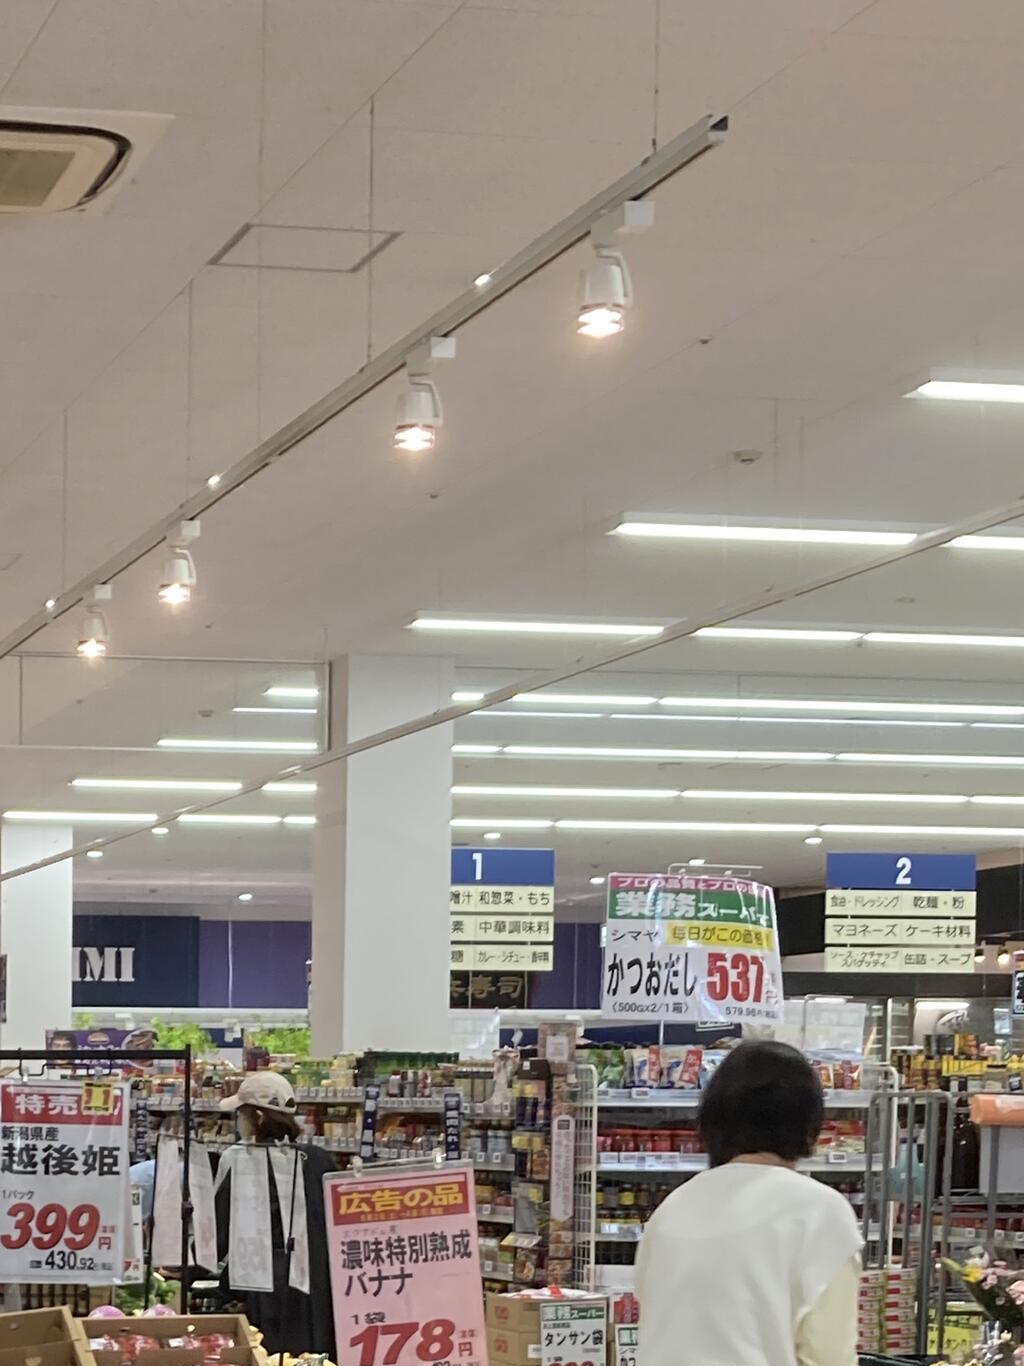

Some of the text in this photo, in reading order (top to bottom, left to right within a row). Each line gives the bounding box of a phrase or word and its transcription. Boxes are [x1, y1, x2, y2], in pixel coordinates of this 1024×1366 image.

[472, 852, 483, 880] 1
[895, 856, 912, 885] 2
[479, 920, 550, 935] 中華調味料
[611, 928, 658, 942] シマヤ
[832, 923, 971, 938] マヨネーズ ケーキ材料
[606, 951, 766, 1003] かつおだし 537
[15, 1094, 79, 1116] 特売
[0, 1125, 60, 1142] 新潟県産
[0, 1144, 121, 1177] 越後姫
[338, 1183, 464, 1216] 広告の品
[0, 1202, 101, 1251] 399
[98, 1236, 112, 1250] 円
[340, 1229, 473, 1270] 濃味特別熟成
[344, 1267, 414, 1297] バナナ
[457, 1341, 474, 1358] 円
[544, 1329, 604, 1348] タンサン袋
